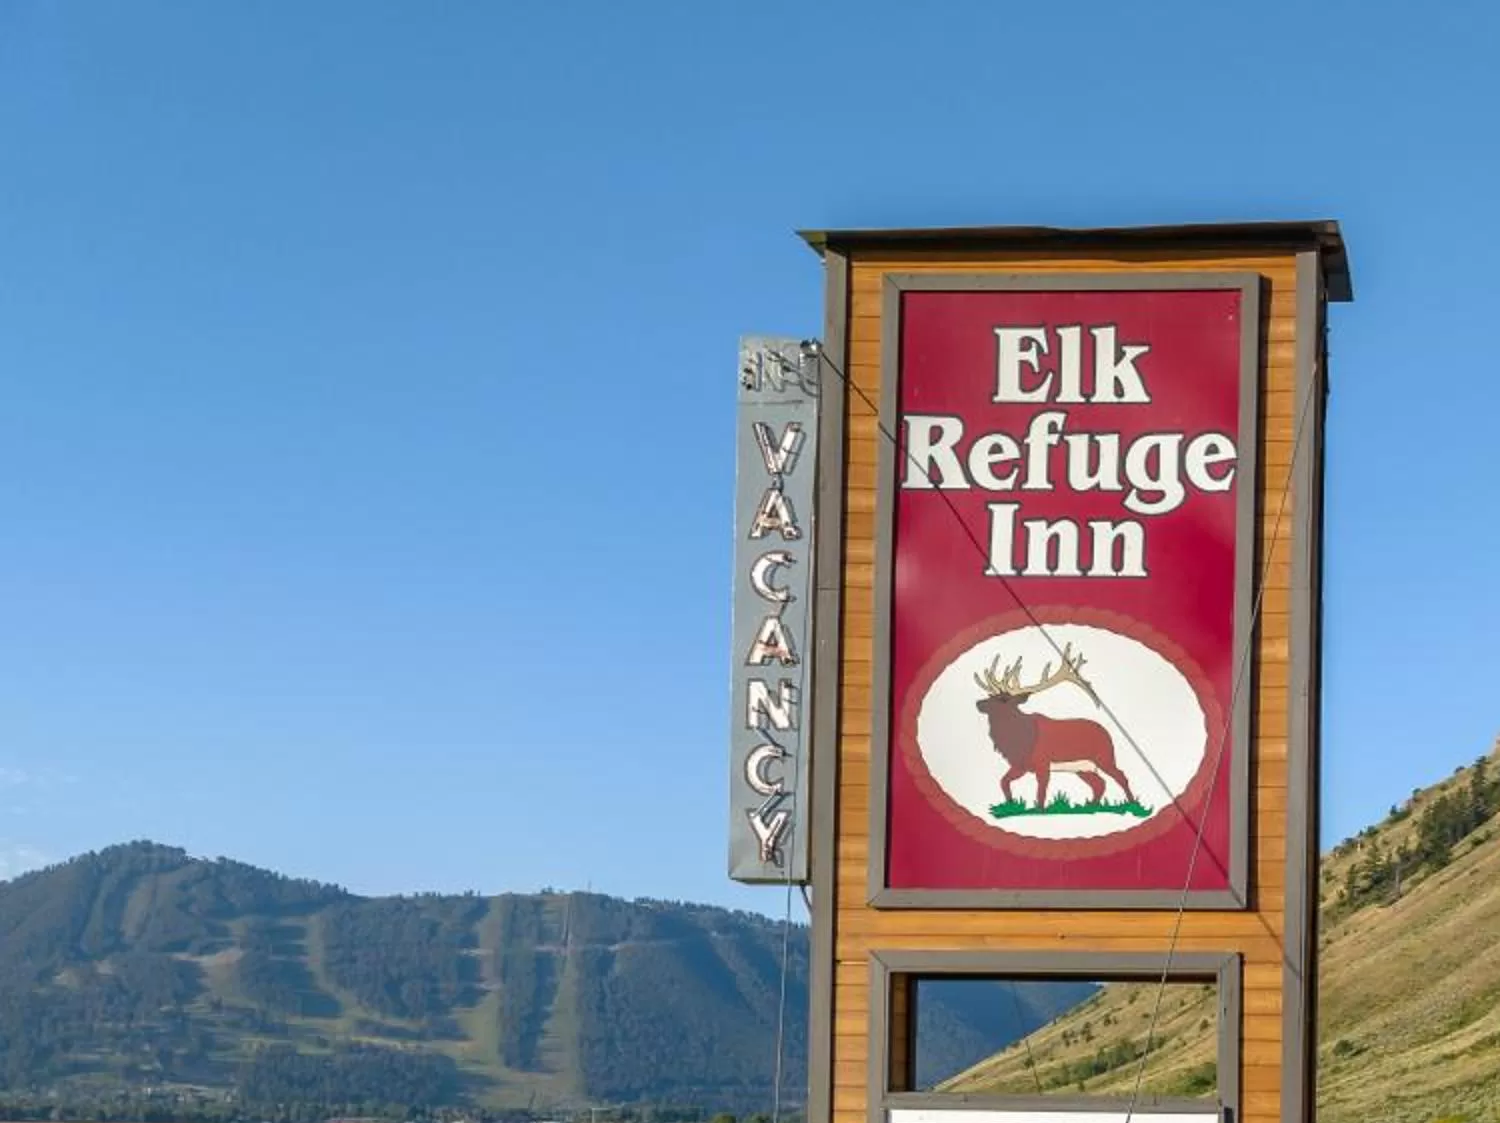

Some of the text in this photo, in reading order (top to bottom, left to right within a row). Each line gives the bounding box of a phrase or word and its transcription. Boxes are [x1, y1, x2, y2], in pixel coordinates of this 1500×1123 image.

[992, 323, 1152, 405] Elk
[901, 411, 1238, 516] Refuge
[982, 500, 1148, 578] Inn
[744, 421, 805, 869] VACANCY
